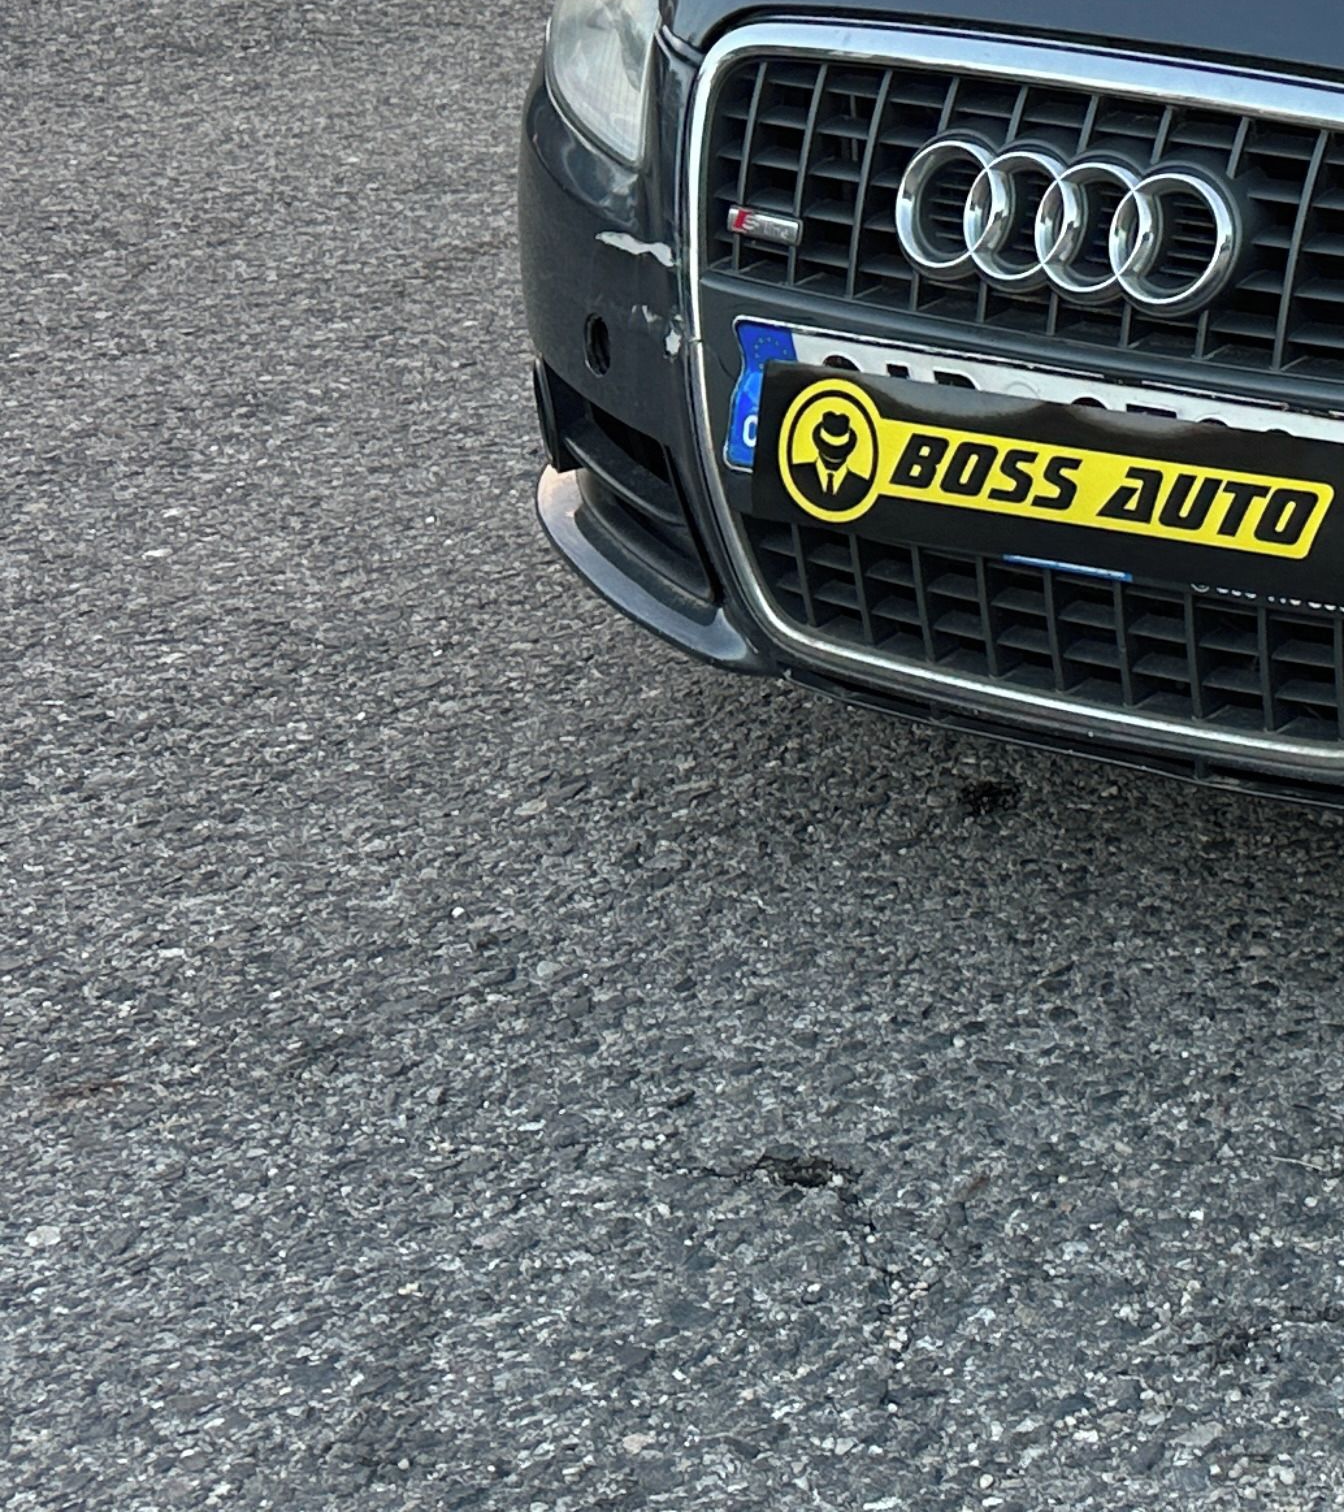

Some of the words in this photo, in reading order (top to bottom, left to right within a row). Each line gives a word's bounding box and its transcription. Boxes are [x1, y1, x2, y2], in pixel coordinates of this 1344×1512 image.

[743, 414, 758, 448] C
[888, 432, 1083, 511] BOSS
[1096, 466, 1319, 546] AUTO
